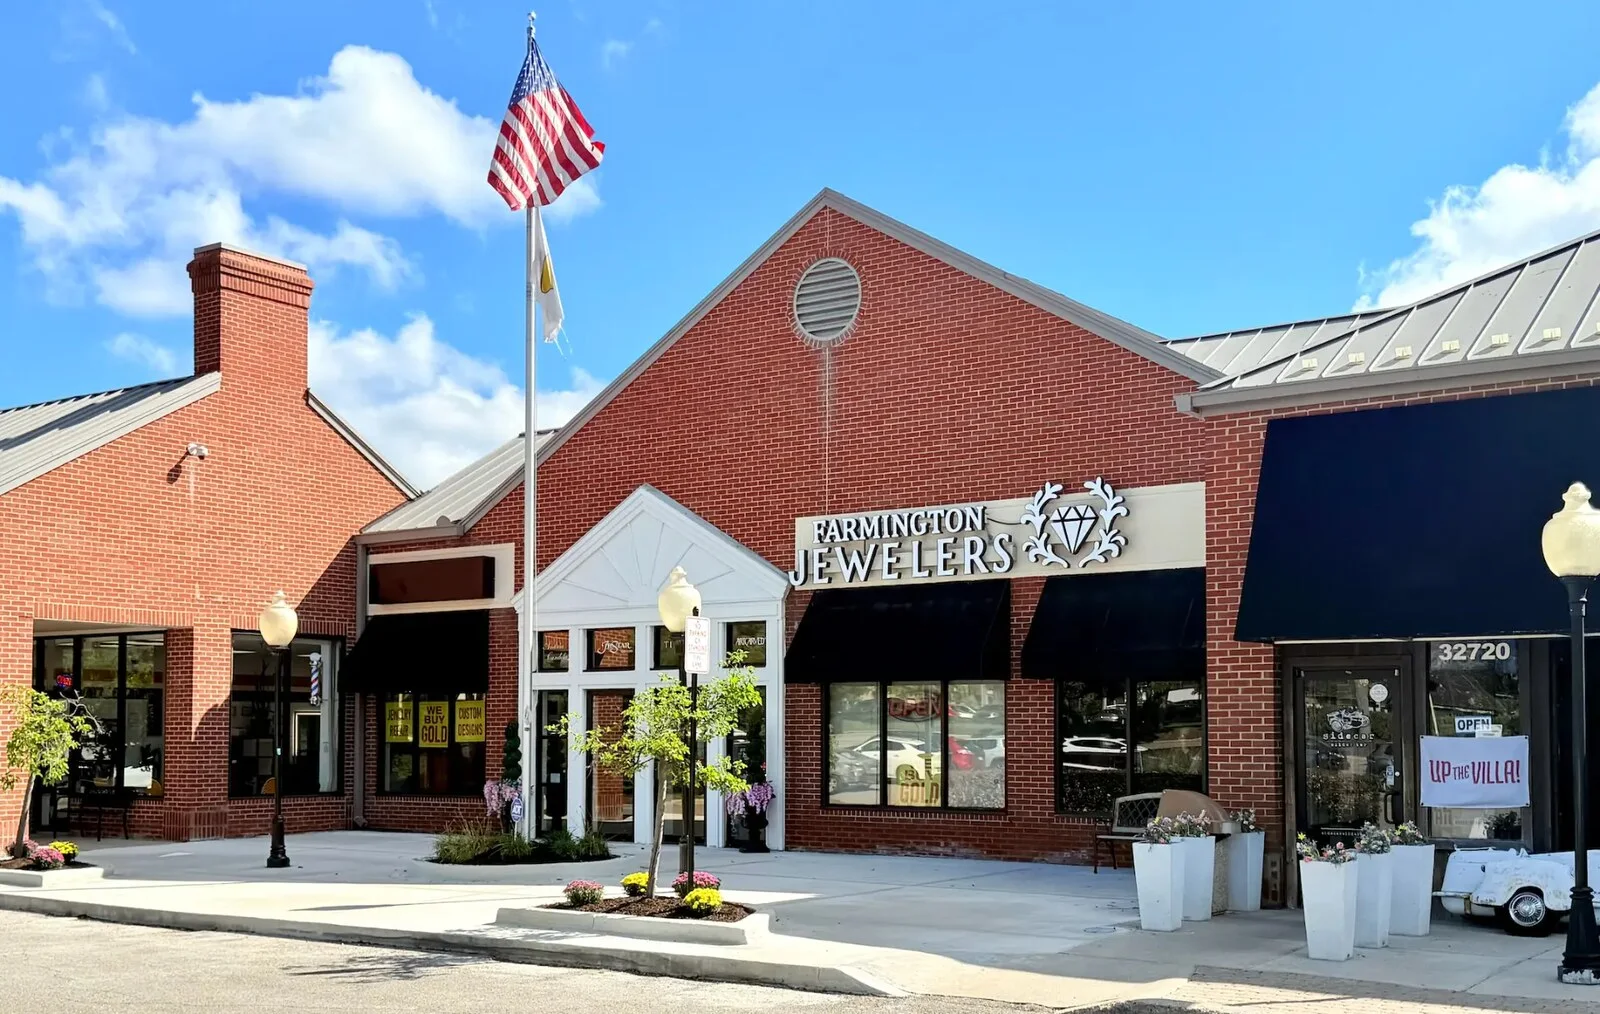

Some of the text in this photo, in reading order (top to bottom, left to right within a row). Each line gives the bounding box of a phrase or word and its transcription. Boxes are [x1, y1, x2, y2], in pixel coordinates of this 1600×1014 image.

[812, 506, 986, 544] FARMINGTON
[788, 533, 1012, 586] JEWELERS
[1439, 643, 1510, 660] 32720
[426, 706, 442, 715] WE
[458, 707, 482, 719] CUSTOM
[887, 697, 941, 717] OPEN
[424, 716, 445, 724] BUY
[1457, 719, 1491, 731] OPEN
[421, 725, 447, 743] GOLD
[458, 723, 483, 737] DESIGNS
[1322, 732, 1375, 741] sidecar
[1429, 760, 1520, 784] UP THE VILLA!
[901, 782, 940, 804] GOLD
